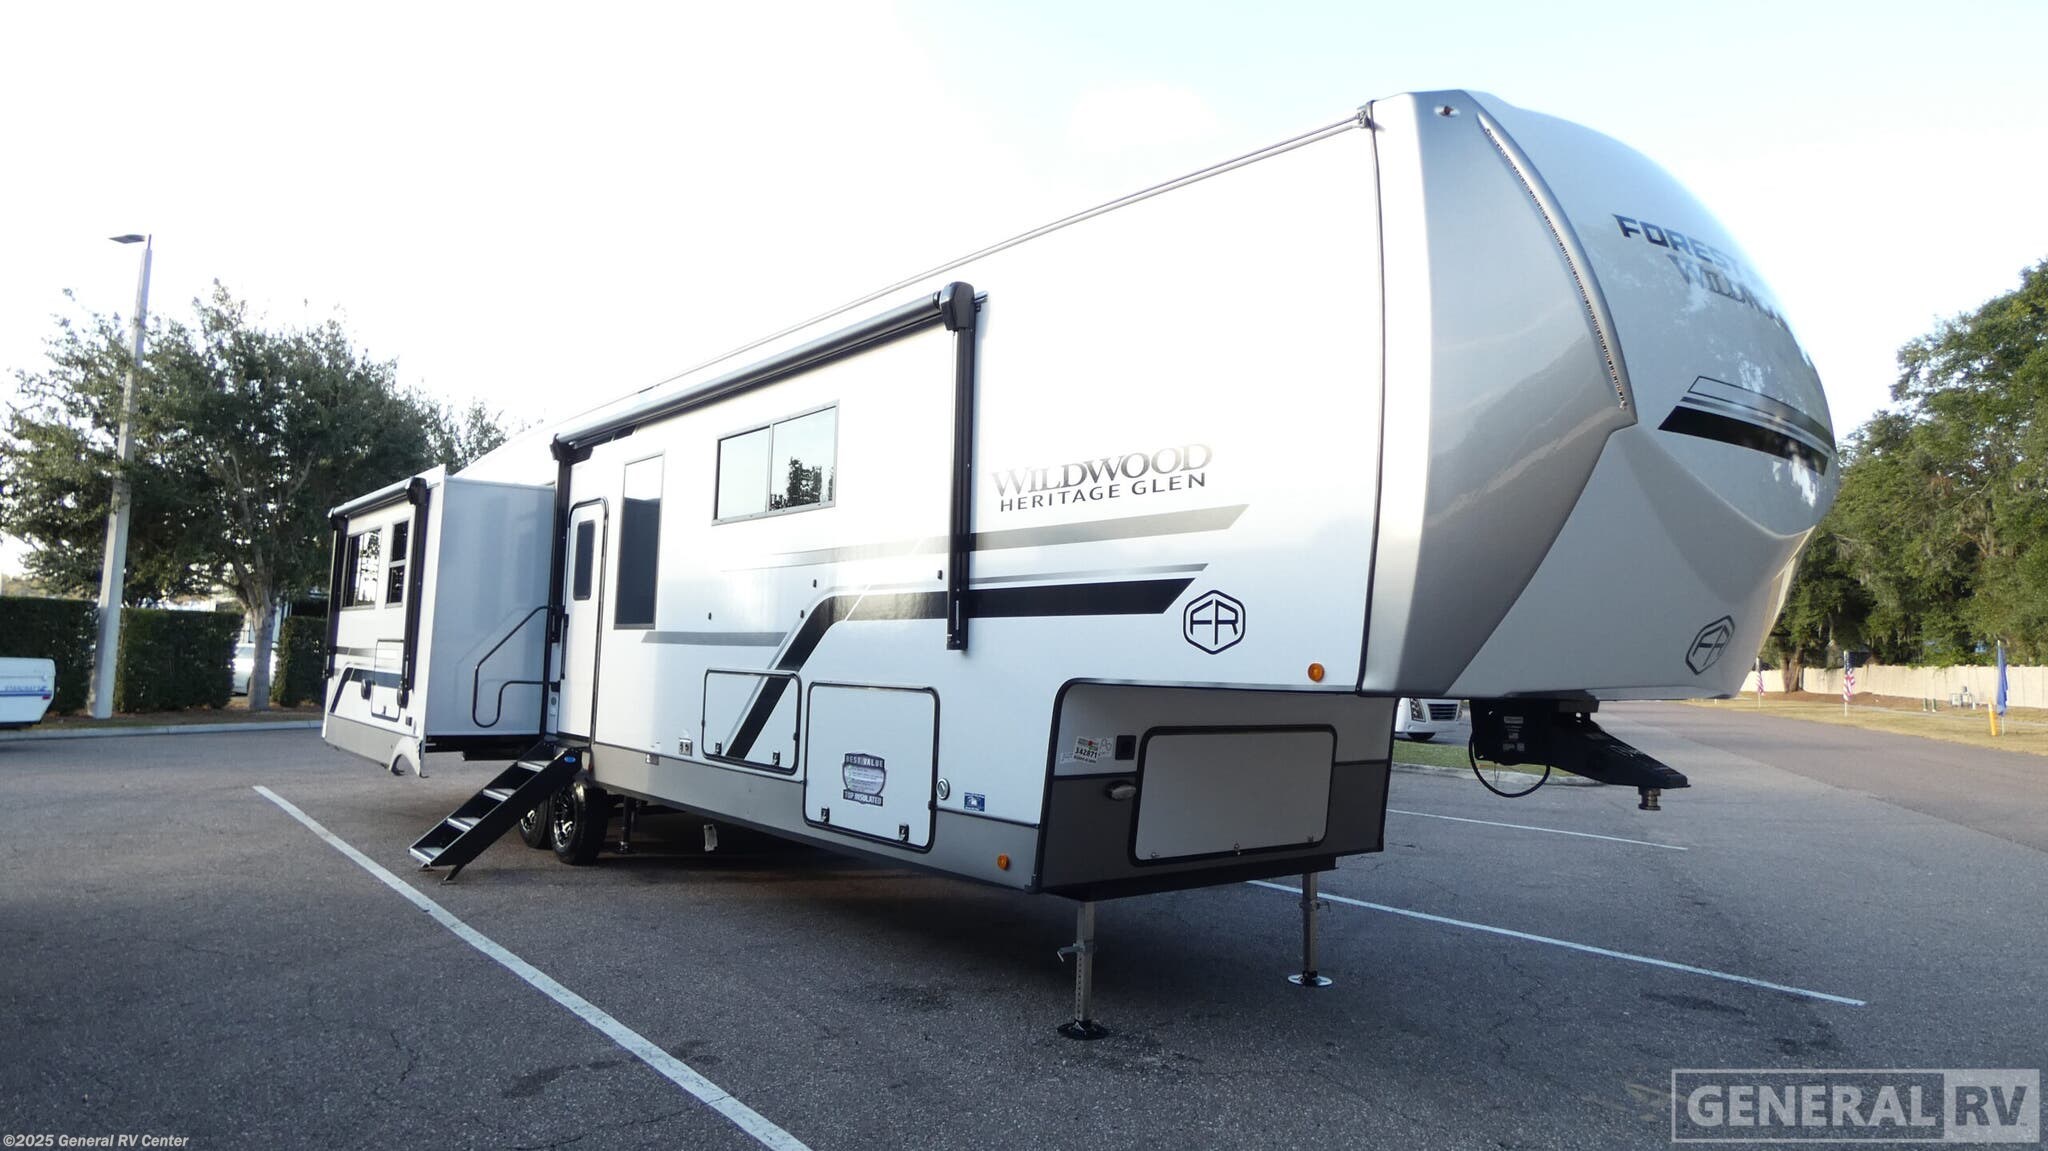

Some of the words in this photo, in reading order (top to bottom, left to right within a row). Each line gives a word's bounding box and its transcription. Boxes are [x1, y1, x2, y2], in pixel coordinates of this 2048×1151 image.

[1612, 214, 1741, 275] FOREST
[992, 443, 1213, 497] WILDWOOD
[1000, 483, 1121, 512] HERITAGE
[1131, 472, 1206, 496] GLEN
[863, 757, 883, 767] VALUE
